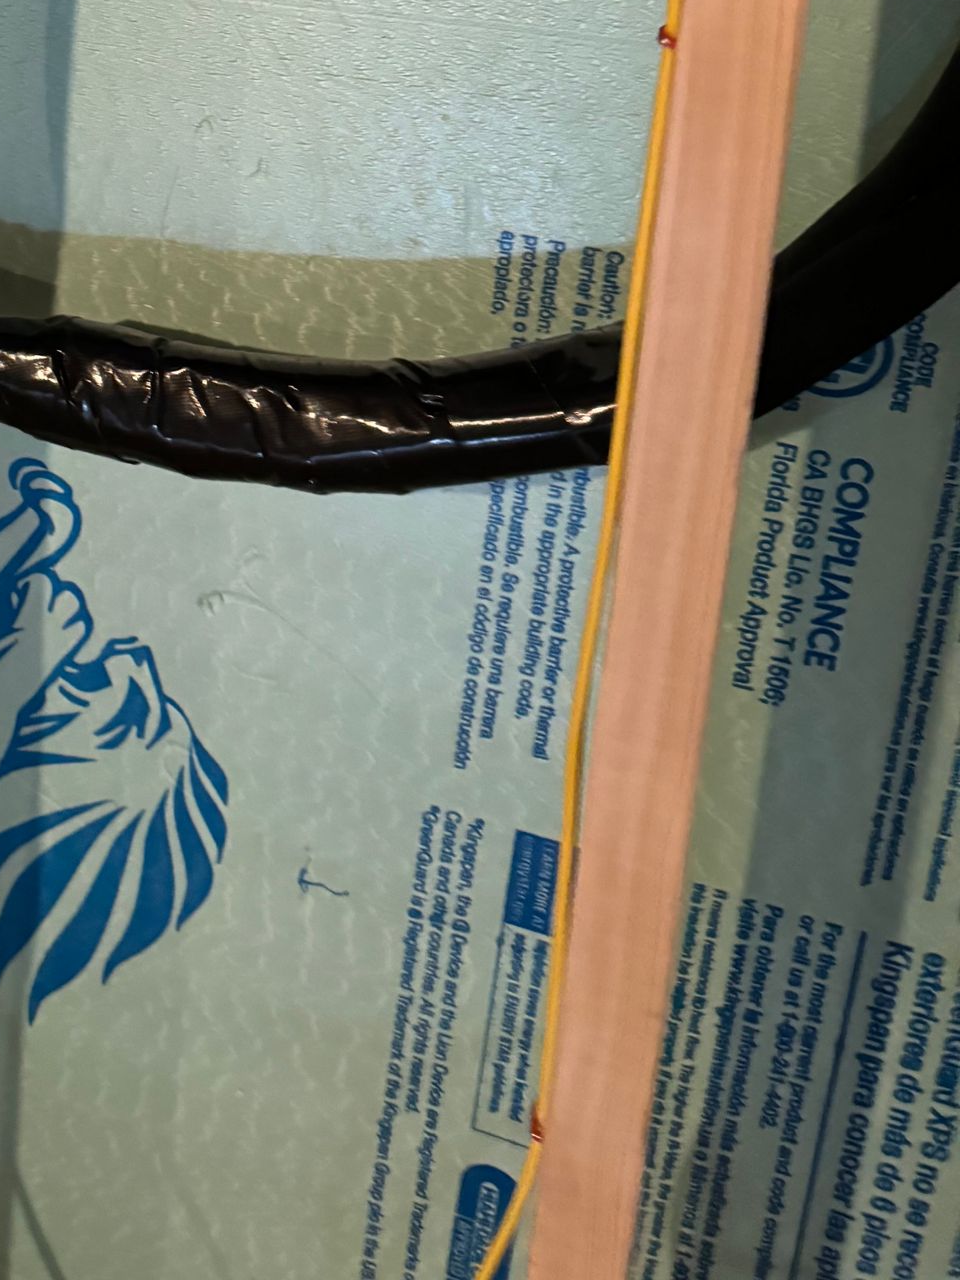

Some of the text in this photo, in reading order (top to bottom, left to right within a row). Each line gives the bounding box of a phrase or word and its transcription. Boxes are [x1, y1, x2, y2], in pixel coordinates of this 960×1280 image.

[486, 231, 512, 317] apropiado.
[536, 241, 565, 334] Precaución:
[599, 250, 624, 321] Caution:
[573, 299, 592, 316] is
[764, 439, 798, 512] Florida
[544, 503, 563, 527] the
[501, 572, 520, 593] Se
[530, 530, 557, 619] appropriate
[748, 518, 784, 599] Product
[763, 450, 831, 707] CA BHGS Lic. No. T 1506;
[804, 457, 873, 671] COMPLIANCE
[468, 604, 492, 653] código
[492, 596, 512, 658] requiere
[518, 619, 546, 677] building
[533, 543, 580, 760] A protective barrier or thermal
[732, 598, 768, 691] Approval
[467, 656, 484, 676] de
[487, 658, 503, 685] una
[516, 676, 538, 719] code.
[454, 679, 478, 769] construcción
[439, 811, 462, 866] Canada
[434, 866, 451, 896] and
[454, 895, 472, 919] the
[746, 904, 784, 1011] Para obtener
[783, 915, 815, 1008] or call us at
[807, 922, 843, 1024] For the most
[418, 997, 435, 1018] All
[438, 1007, 457, 1033] the
[441, 978, 457, 1010] and
[387, 1060, 403, 1081] of
[434, 1032, 453, 1064] Lion
[384, 1076, 403, 1103] the
[828, 940, 913, 1246] Kingspan para conocer las
[868, 953, 945, 1216] exteriores de más de 6
[415, 1128, 438, 1202] Registered
[905, 1105, 956, 1230] XPS no se
